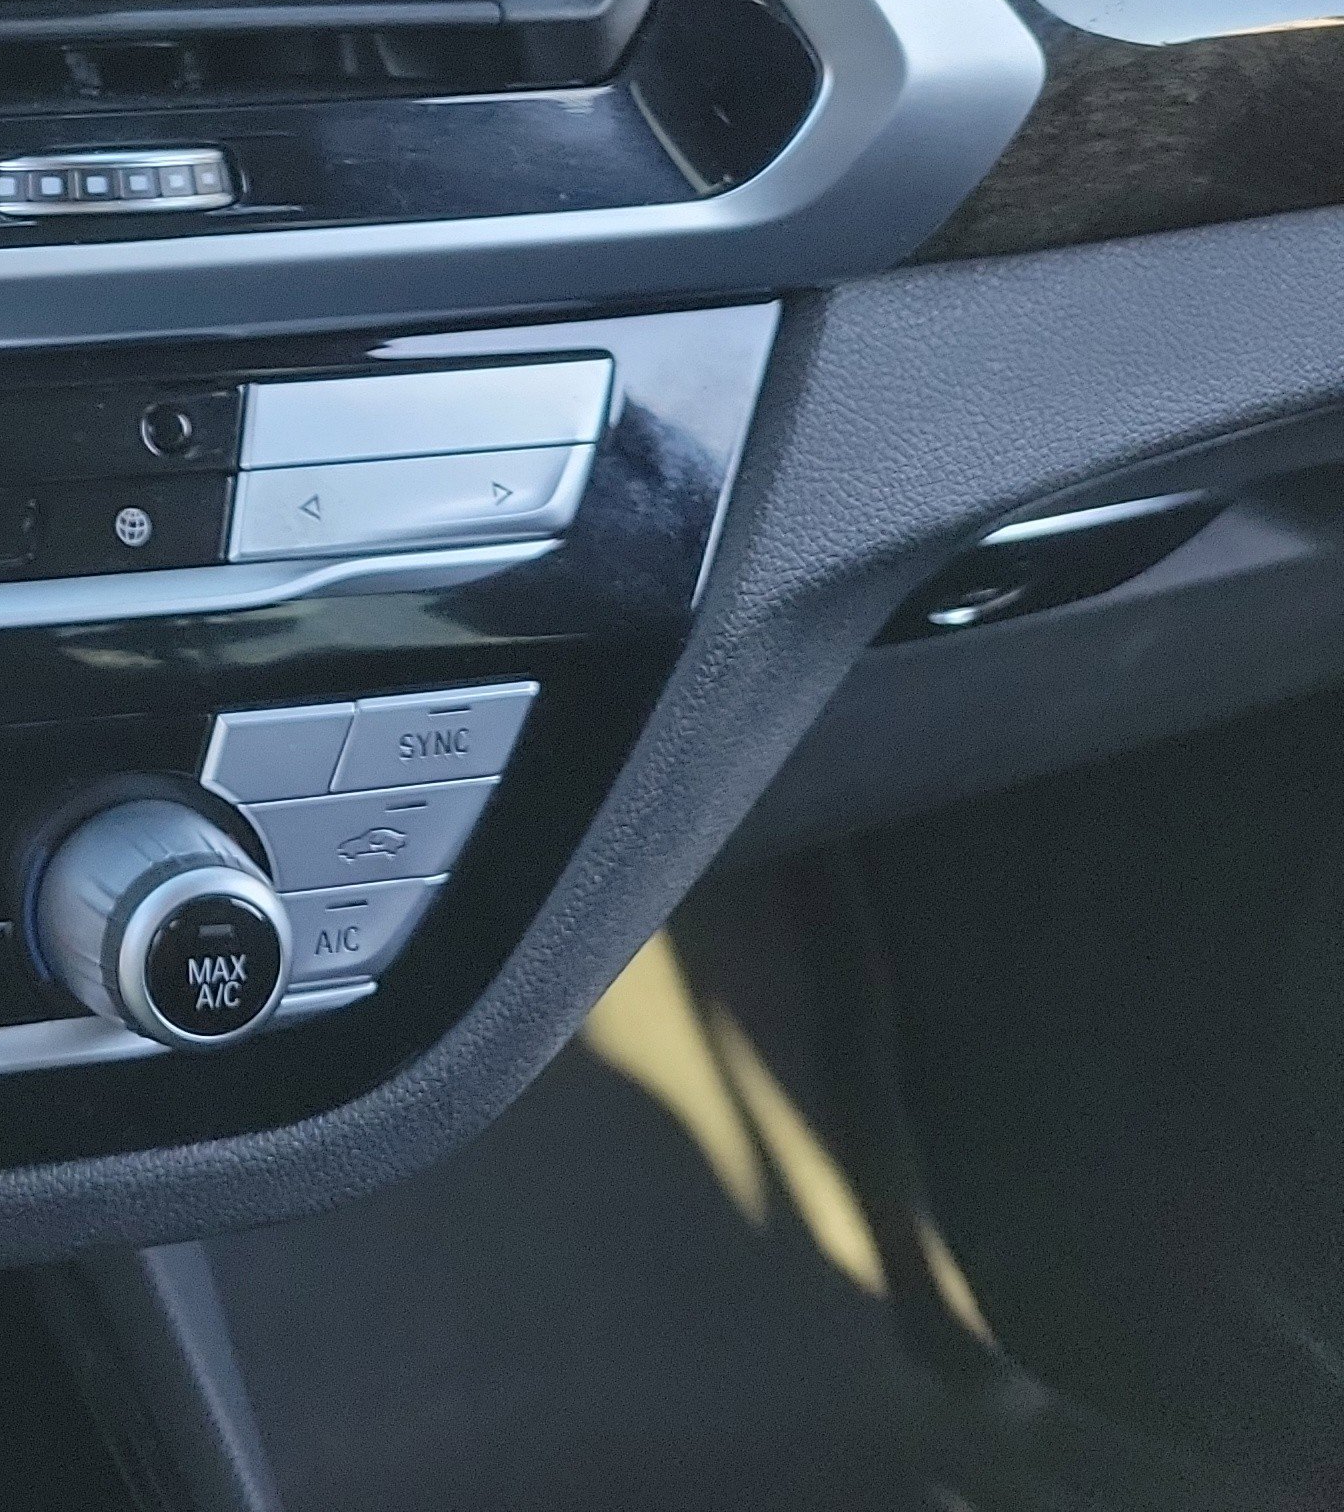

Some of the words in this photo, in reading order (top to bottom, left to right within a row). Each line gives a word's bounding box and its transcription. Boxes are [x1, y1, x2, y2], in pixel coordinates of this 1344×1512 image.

[398, 728, 470, 760] SYNC
[315, 925, 360, 954] A/C
[188, 954, 247, 983] MAX
[196, 981, 240, 1009] A/C
